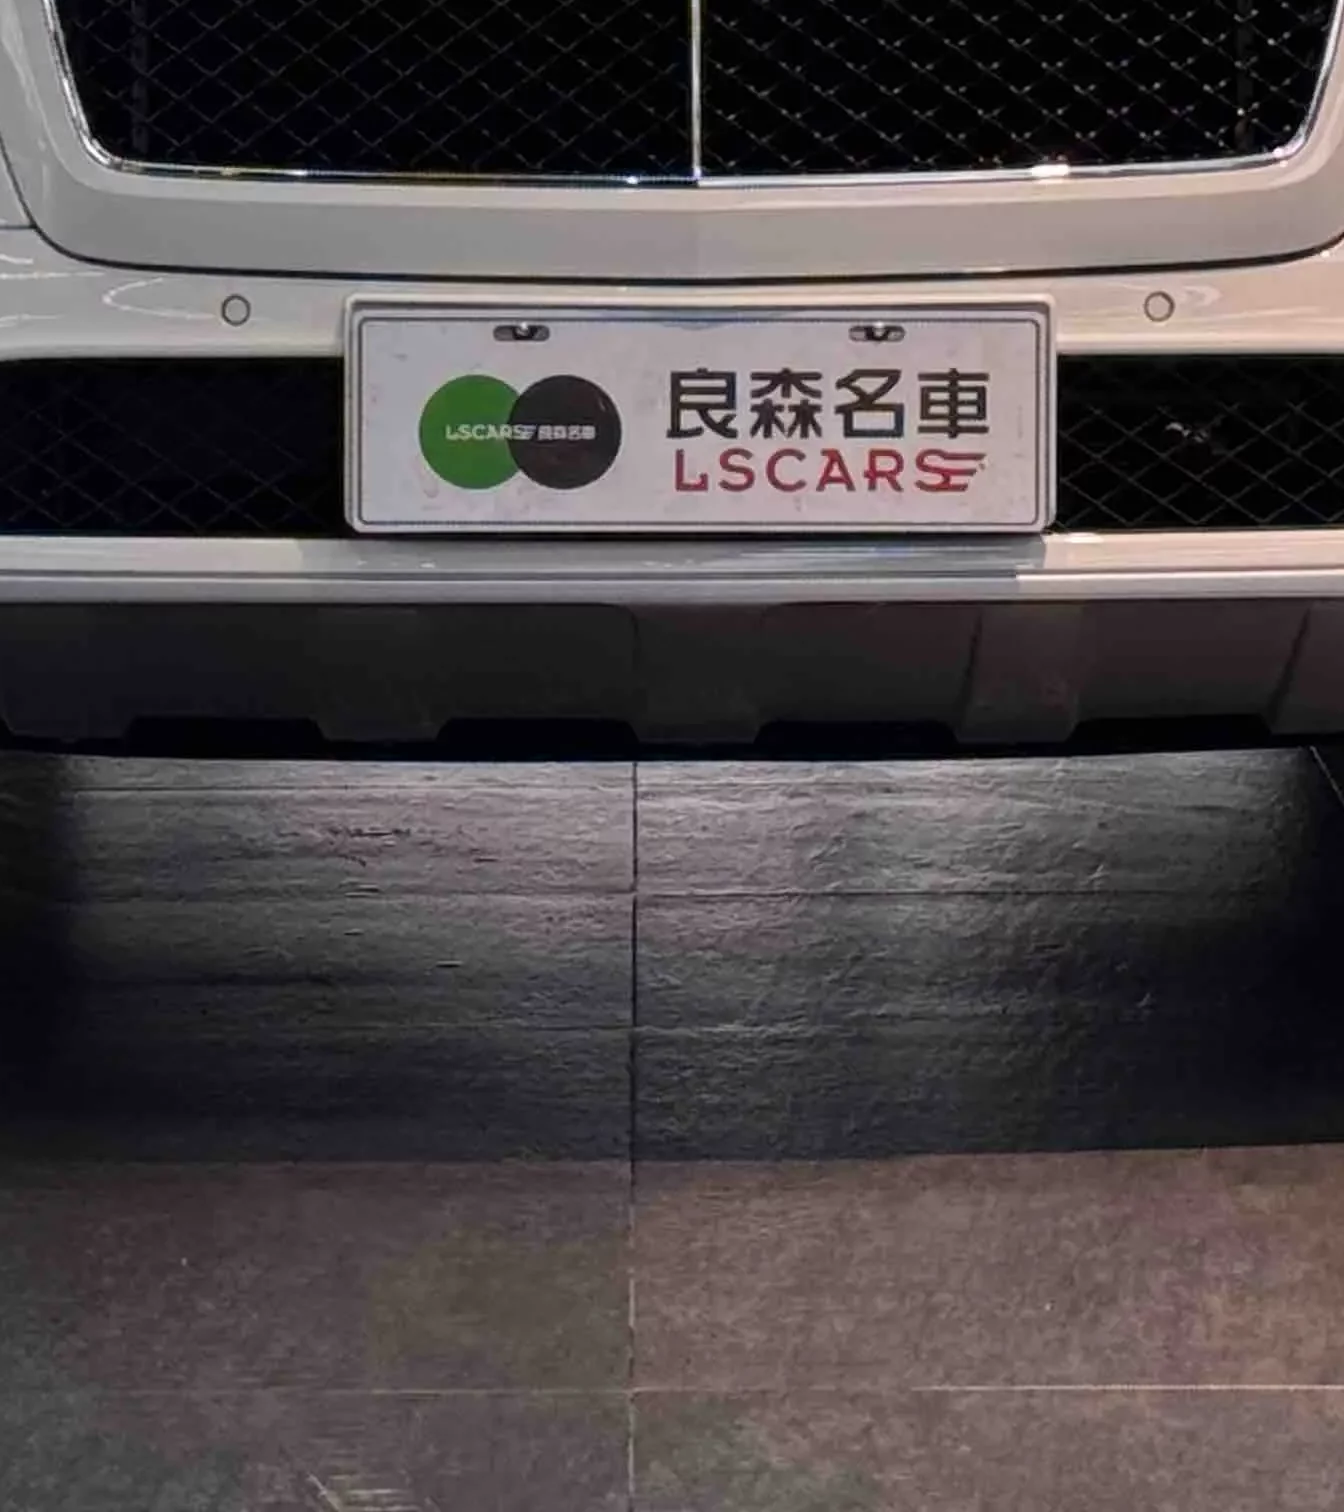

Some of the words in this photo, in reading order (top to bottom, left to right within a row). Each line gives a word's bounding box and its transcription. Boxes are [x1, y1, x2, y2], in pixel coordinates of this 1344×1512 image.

[666, 368, 991, 439] 良森名車
[675, 447, 988, 493] LSCARS
